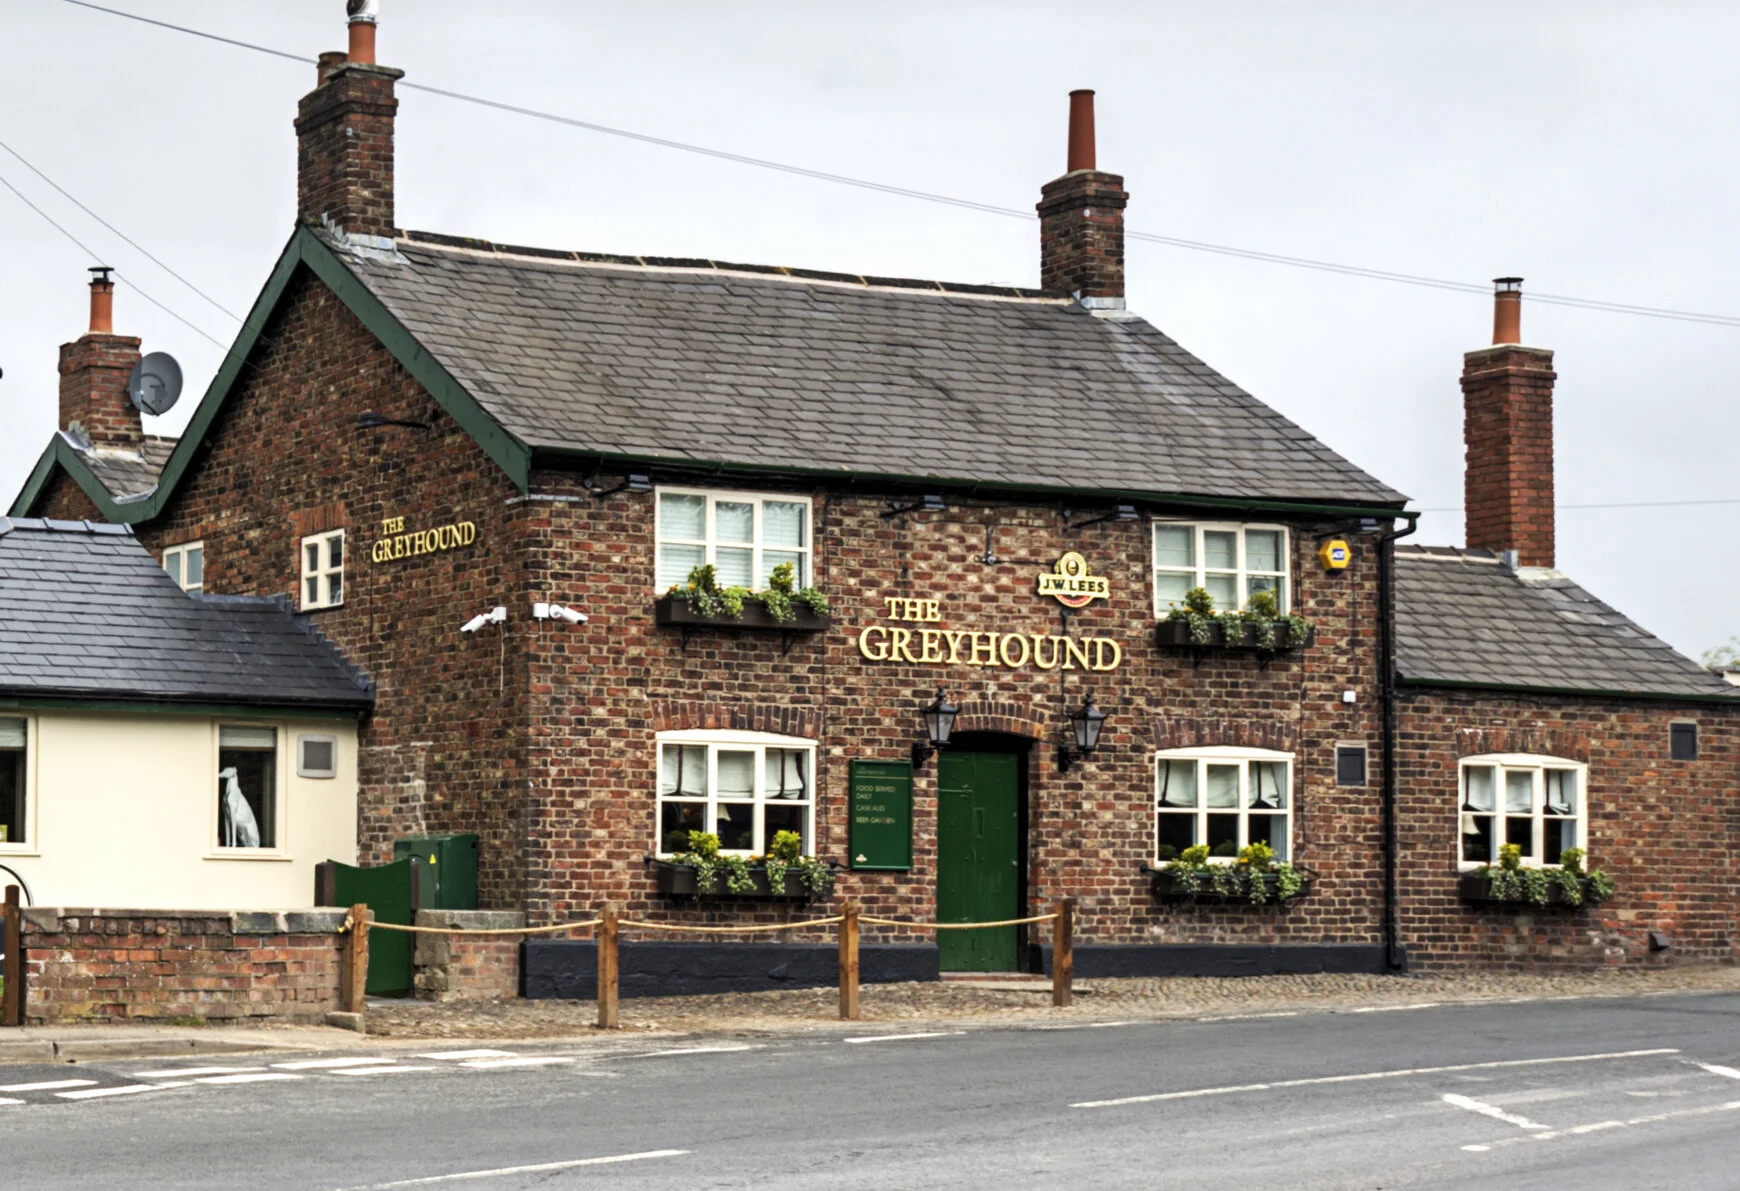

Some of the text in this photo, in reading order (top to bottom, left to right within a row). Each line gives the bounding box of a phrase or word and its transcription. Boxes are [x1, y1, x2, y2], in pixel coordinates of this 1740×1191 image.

[382, 516, 405, 535] THE
[372, 521, 476, 562] GREYHOUND
[1069, 580, 1105, 592] LEES
[884, 597, 941, 622] THE
[859, 625, 1122, 671] GREYHOUND
